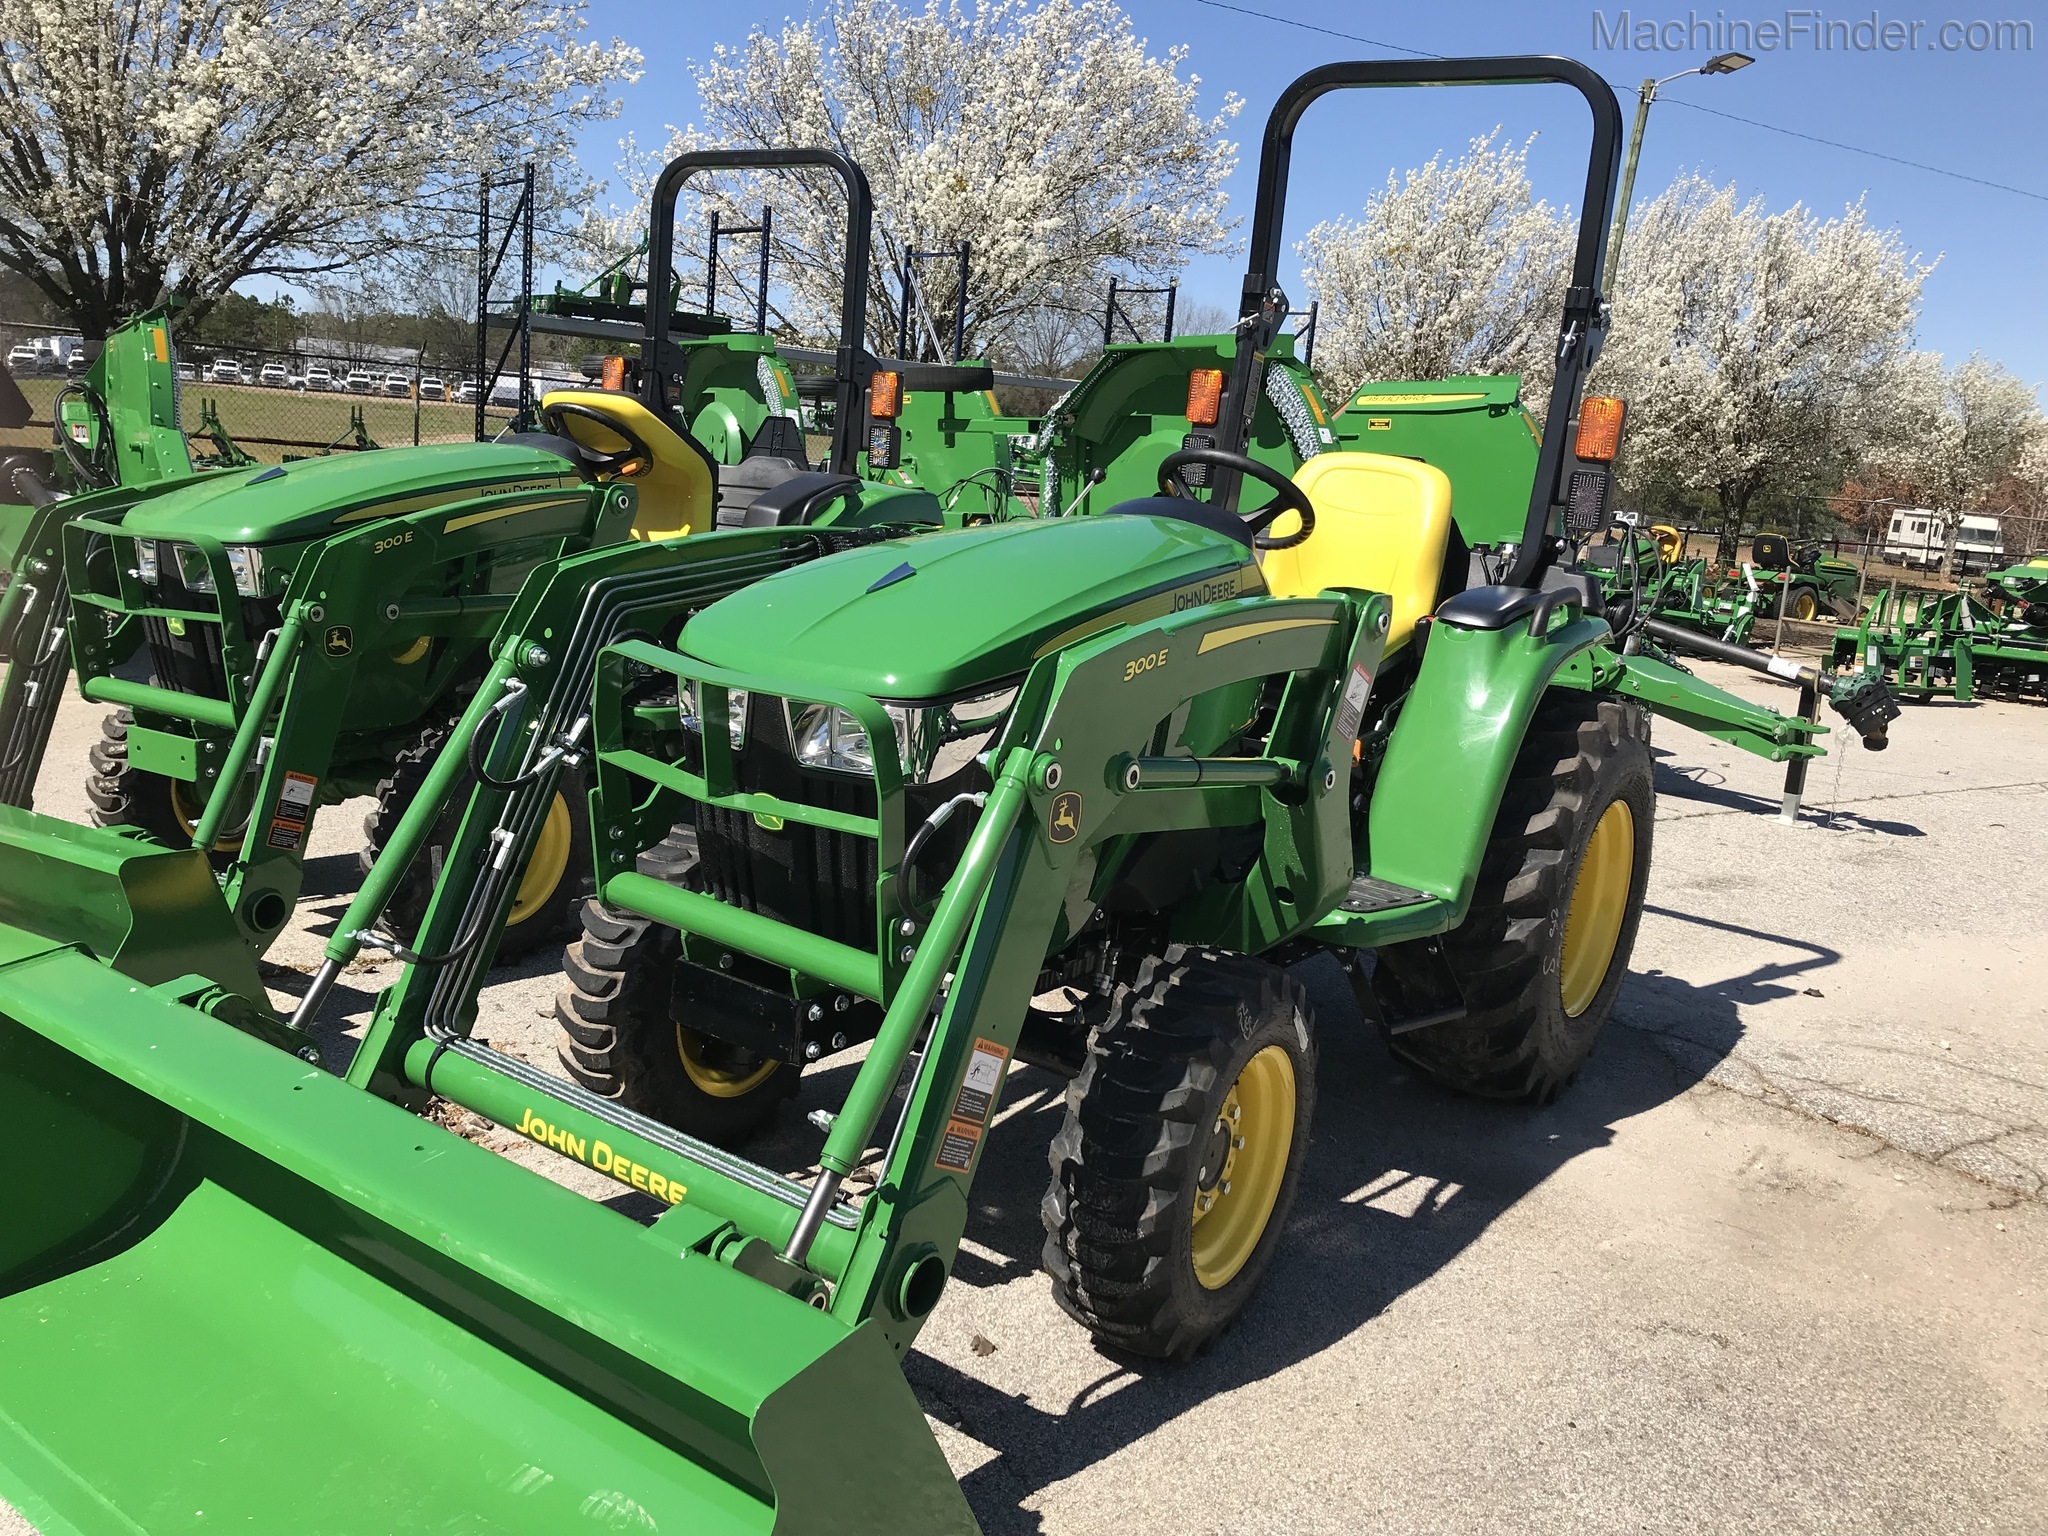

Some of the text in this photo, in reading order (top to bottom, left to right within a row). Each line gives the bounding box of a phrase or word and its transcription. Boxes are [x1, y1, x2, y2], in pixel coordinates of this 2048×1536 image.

[1169, 580, 1235, 614] JOHN DEERE
[983, 1041, 1005, 1057] WARNING
[956, 1125, 978, 1138] WARNING
[515, 1108, 688, 1205] JOHN DEERE
